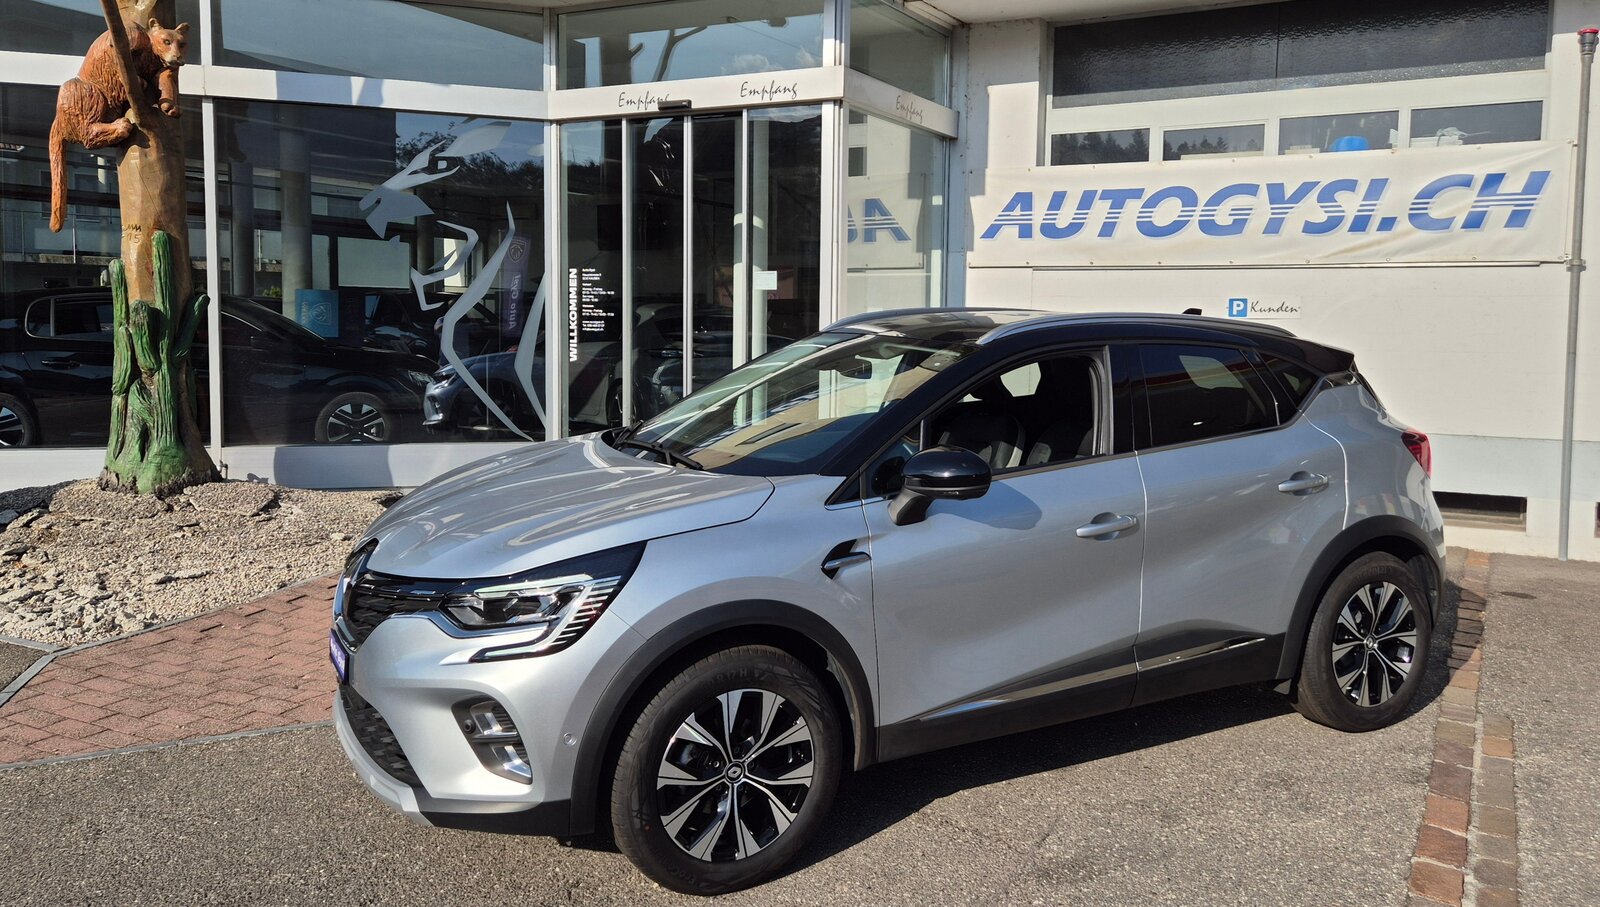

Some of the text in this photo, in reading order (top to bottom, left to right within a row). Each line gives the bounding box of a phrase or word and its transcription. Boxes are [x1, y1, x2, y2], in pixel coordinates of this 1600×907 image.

[740, 79, 798, 102] Empfang
[895, 95, 923, 125] Empfang
[979, 170, 1552, 239] AUTOGYSI.CH
[569, 268, 578, 362] WILLKOMMEN
[1250, 300, 1299, 313] Kunden
